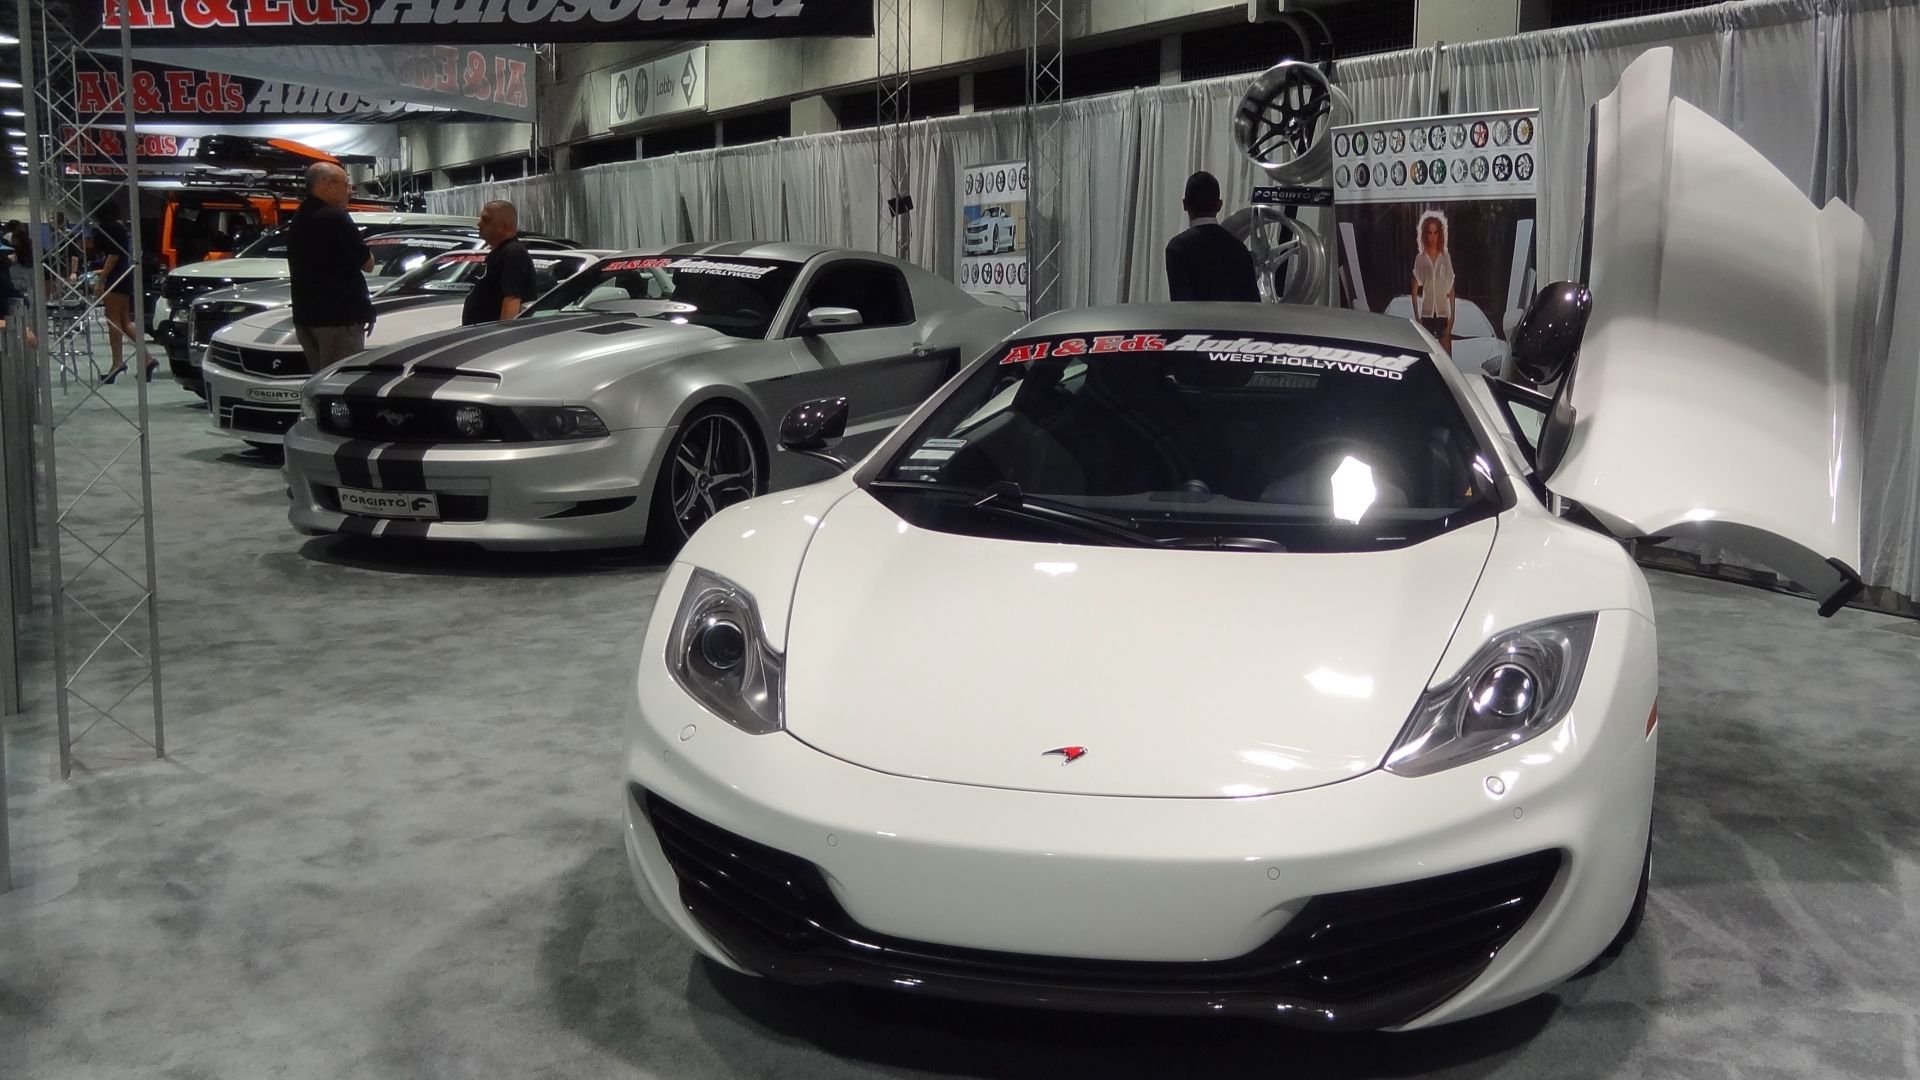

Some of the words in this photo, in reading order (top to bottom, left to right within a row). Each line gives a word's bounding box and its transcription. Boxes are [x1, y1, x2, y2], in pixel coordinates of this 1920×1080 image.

[244, 0, 371, 26] Eds
[77, 71, 126, 113] Al
[131, 71, 165, 113] &
[246, 79, 458, 113] Autos
[656, 74, 675, 96] Lobby
[1254, 190, 1311, 199] FORGIATO
[704, 269, 762, 280] HOLLYWOOD
[1000, 342, 1051, 365] Al
[1052, 339, 1088, 357] &
[1162, 334, 1421, 372] Autosound
[1208, 351, 1268, 364] WEST
[1272, 355, 1404, 381] HOLLYWOOD
[248, 390, 299, 398] FORGIATO
[341, 493, 407, 507] FORGIATO
